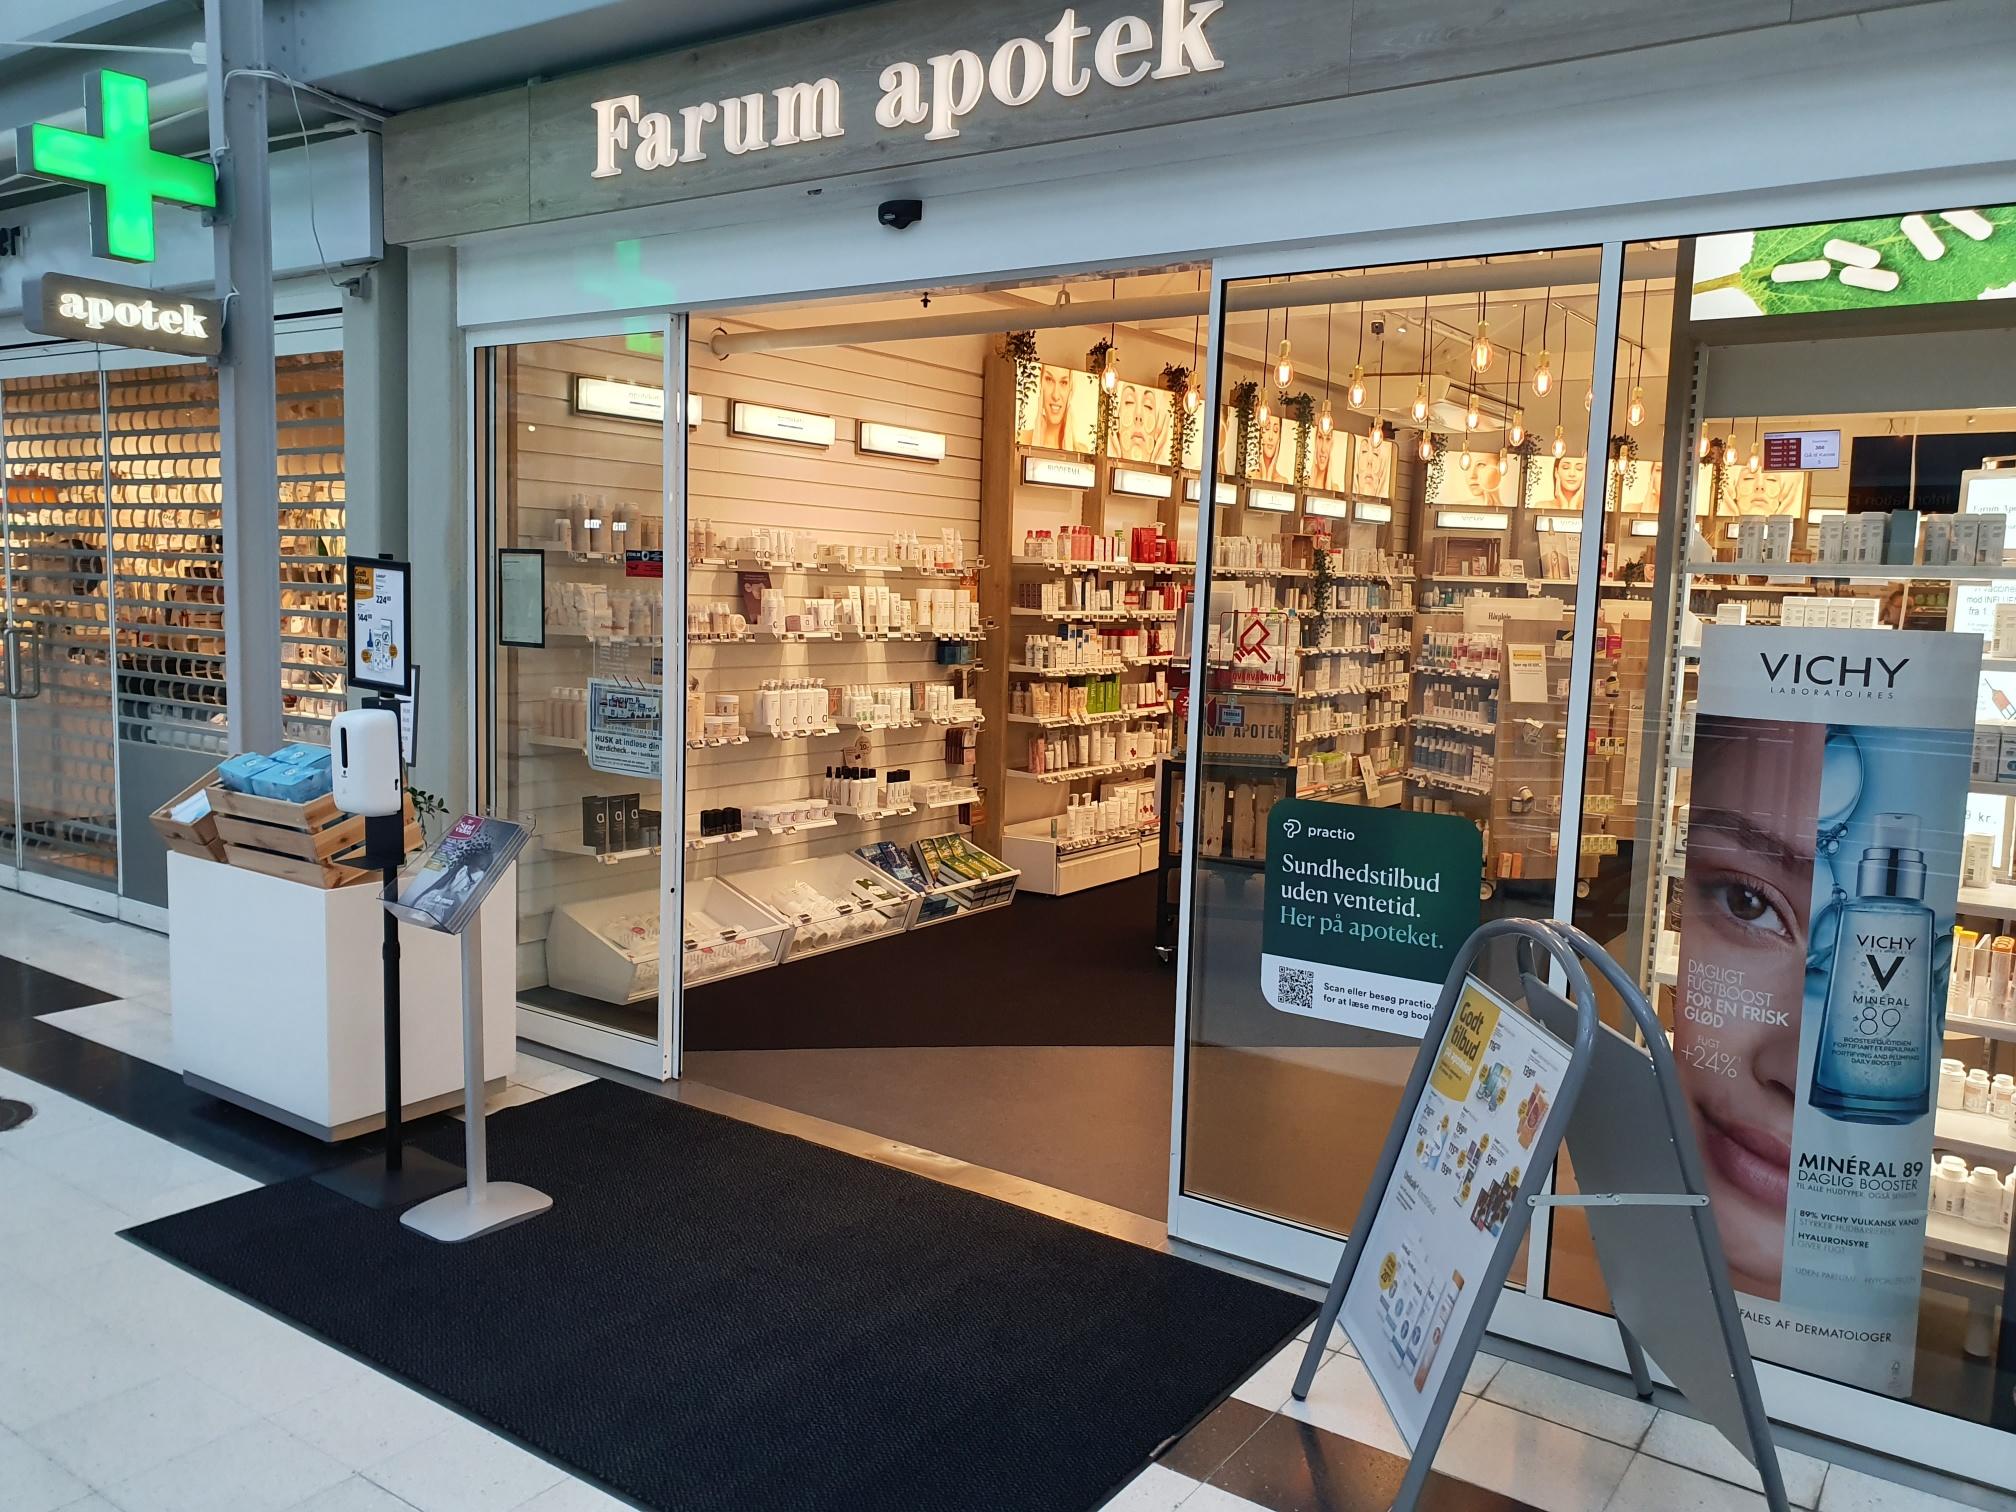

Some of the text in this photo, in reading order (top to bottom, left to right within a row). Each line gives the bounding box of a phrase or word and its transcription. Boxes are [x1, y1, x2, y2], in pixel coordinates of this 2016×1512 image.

[590, 0, 1225, 179] Farum apotek
[59, 293, 209, 339] apotek
[1760, 652, 1910, 688] VICHY
[1770, 686, 1895, 700] LABORATOIRES
[594, 735, 613, 744] HUSK
[648, 741, 660, 750] din
[1233, 723, 1283, 739] APOTEK
[1308, 826, 1356, 841] practio
[1282, 853, 1440, 893] Sundhedstilbud
[1281, 881, 1421, 918] uden ventetid.
[1280, 905, 1443, 949] Her på apoteket.
[1856, 934, 1917, 950] VICHY
[1688, 958, 1745, 985] DAGLIGT
[1323, 982, 1436, 1010] Scan eller besøg practio.
[1687, 974, 1775, 1008] FUGTBOOST
[1323, 994, 1336, 1003] for
[1337, 997, 1346, 1006] at
[1348, 1000, 1369, 1010] læse
[1371, 1005, 1395, 1015] mere
[1397, 1009, 1409, 1019] og
[1459, 1001, 1485, 1035] Godt
[1684, 1006, 1724, 1028] GLØD
[1686, 989, 1790, 1027] FOR EN FRISK
[1859, 1006, 1901, 1038] 89
[1450, 1024, 1481, 1062] tilbud
[1697, 1034, 1720, 1049] FUGT
[1832, 1042, 1873, 1051] FORTIFIANT
[1843, 1036, 1875, 1045] BOOSTER
[1831, 1050, 1872, 1059] FORTIFYING
[1798, 1152, 1923, 1178] MINÉRAL 89
[1796, 1182, 1805, 1190] TIL
[1807, 1184, 1823, 1192] ALLE
[1798, 1169, 1918, 1191] DAGLIG BOOSTER
[1799, 1209, 1920, 1227] 89% VICHY VULKANSK VAND
[1798, 1232, 1870, 1249] HYALURONSYRE
[1775, 1319, 1791, 1330] AF
[1795, 1322, 1892, 1343] DERMATOLOGER
